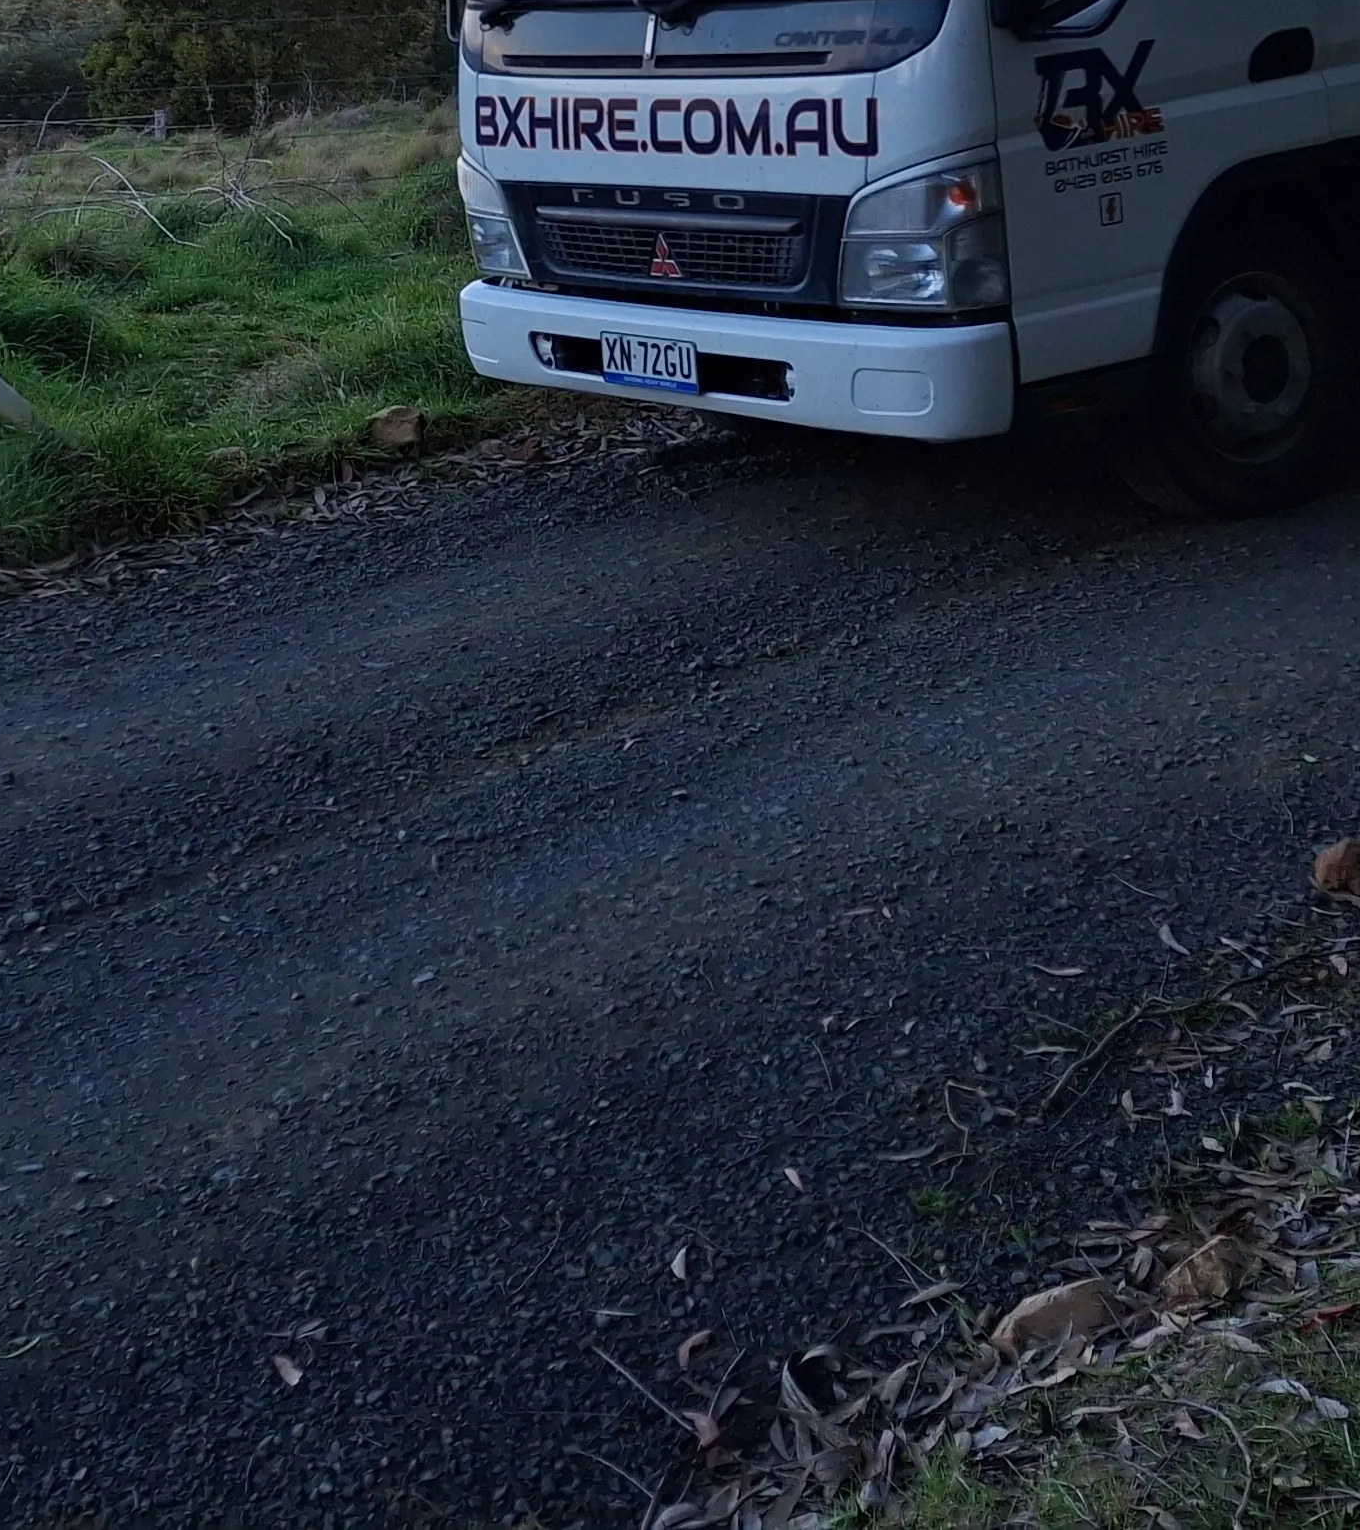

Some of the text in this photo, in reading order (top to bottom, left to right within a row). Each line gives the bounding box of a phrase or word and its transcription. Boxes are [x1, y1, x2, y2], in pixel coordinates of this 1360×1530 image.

[475, 95, 879, 158] BXHIRE.COM.AU
[1045, 140, 1169, 176] BATHURST HIRE
[1053, 172, 1097, 194] 0423
[1101, 166, 1133, 185] 055
[571, 187, 745, 211] FUSO
